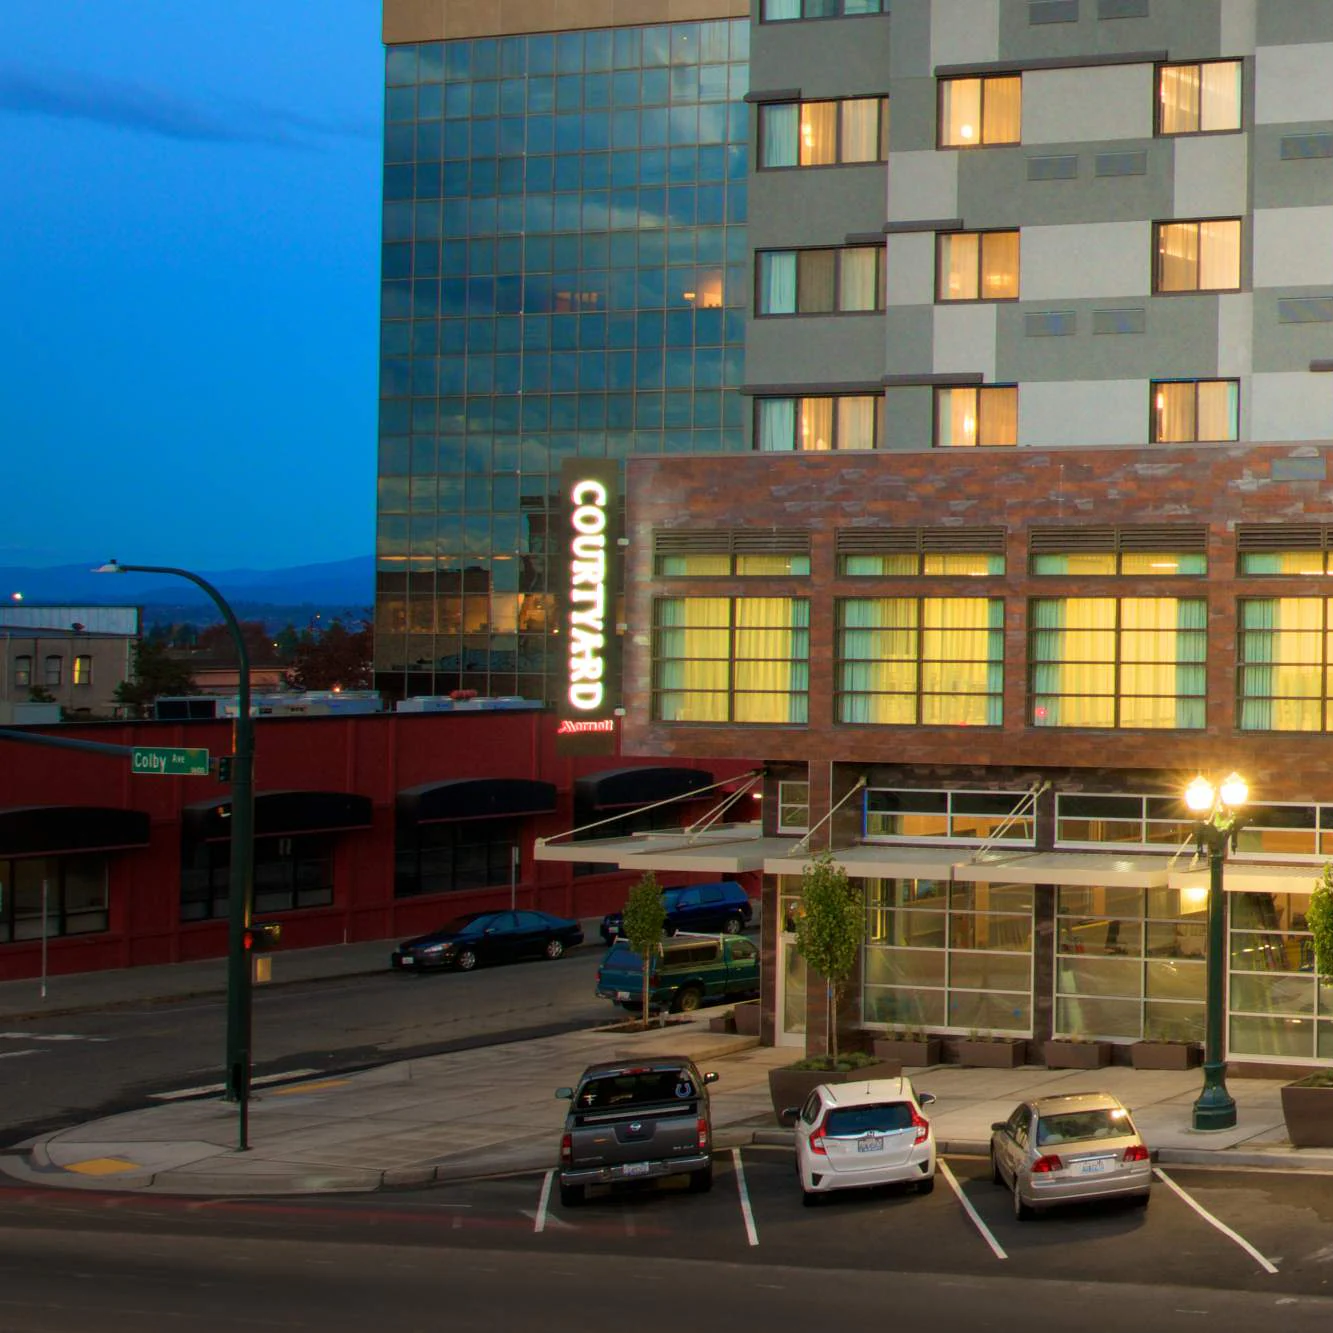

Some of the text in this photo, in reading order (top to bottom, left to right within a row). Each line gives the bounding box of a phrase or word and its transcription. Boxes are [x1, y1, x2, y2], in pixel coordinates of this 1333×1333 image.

[570, 480, 606, 709] COURTYARD
[557, 720, 614, 733] Marriott
[135, 752, 166, 773] Colby
